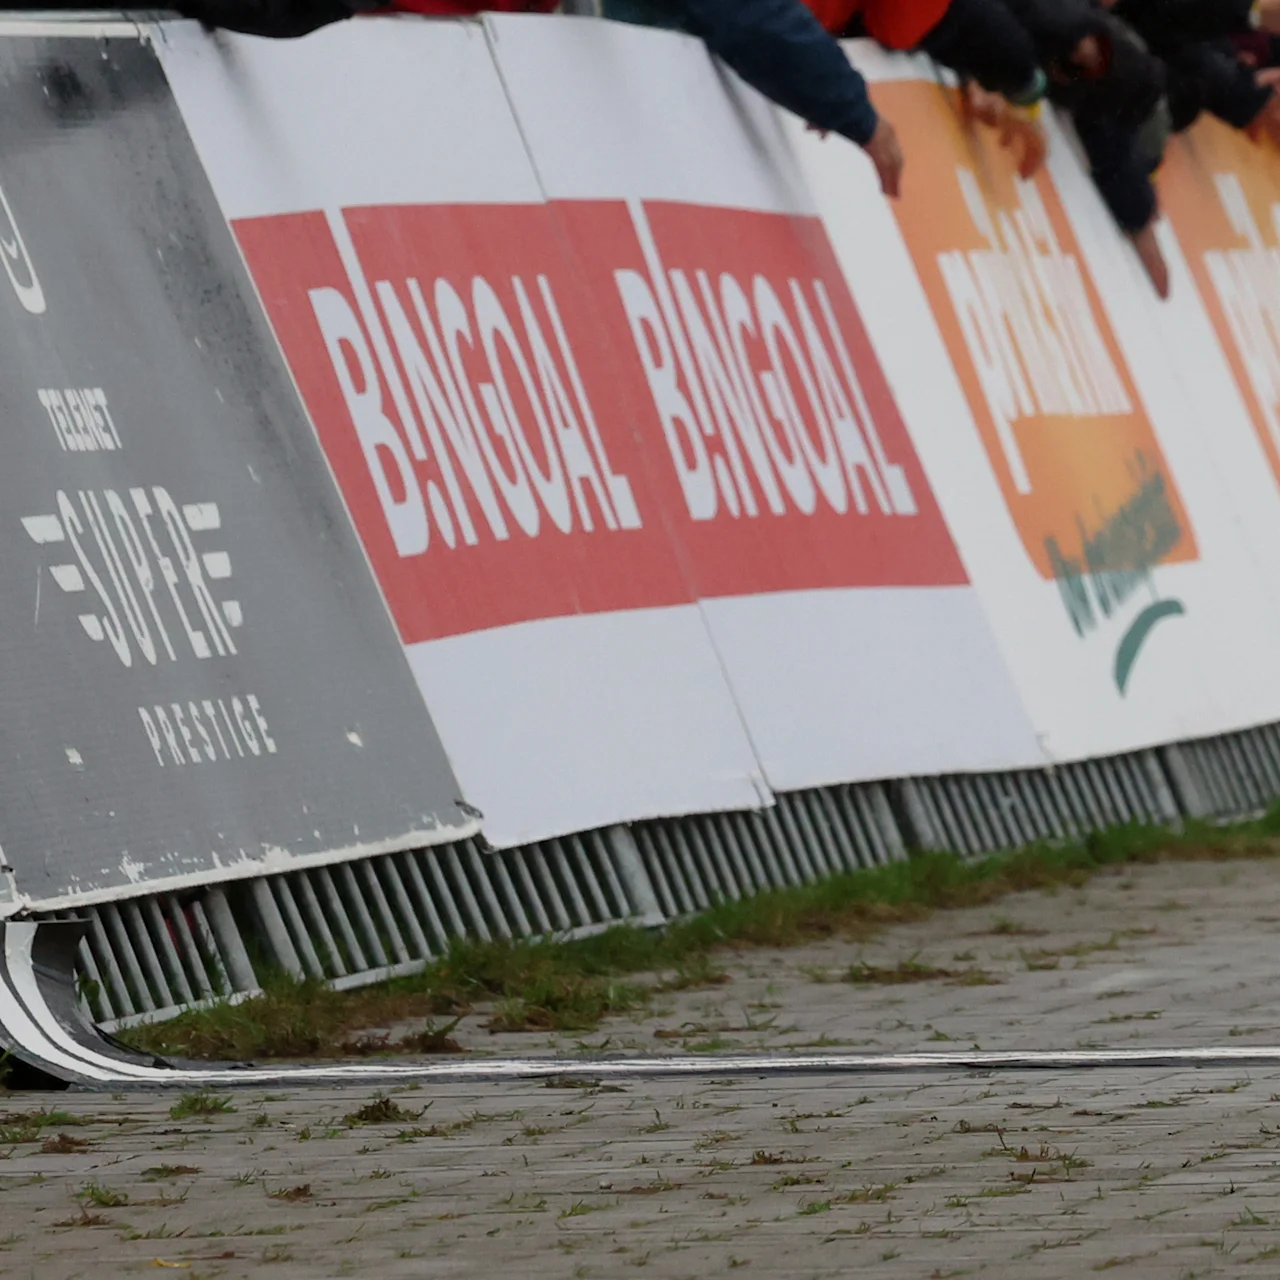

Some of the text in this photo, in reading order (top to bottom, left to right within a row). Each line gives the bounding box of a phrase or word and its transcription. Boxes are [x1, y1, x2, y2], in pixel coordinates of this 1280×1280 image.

[38, 388, 122, 452] TELENET
[56, 485, 238, 668] SUPER
[138, 694, 277, 767] PRESTIGE
